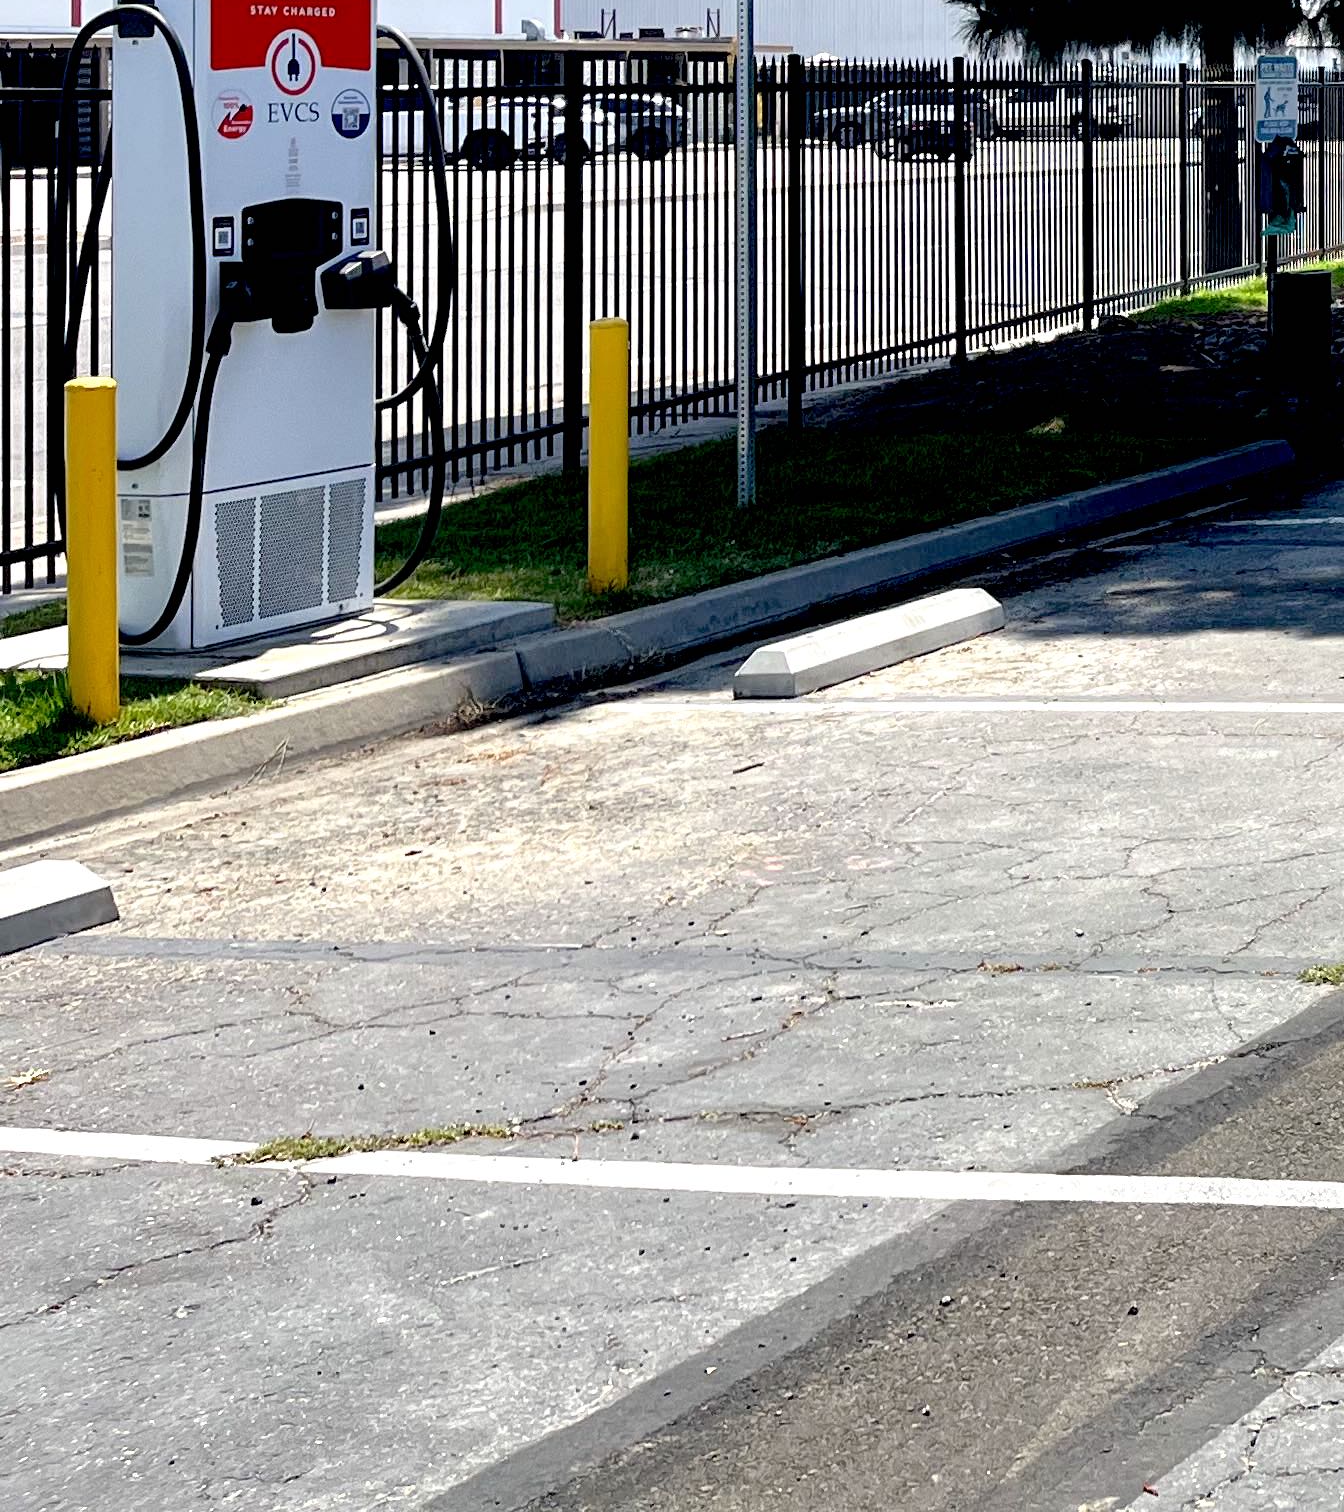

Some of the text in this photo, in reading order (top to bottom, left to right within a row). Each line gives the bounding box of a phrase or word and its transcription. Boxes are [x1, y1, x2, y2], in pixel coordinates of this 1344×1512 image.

[250, 5, 336, 17] STAY CHARGED
[268, 101, 320, 123] EVCS
[223, 124, 247, 133] Energy
